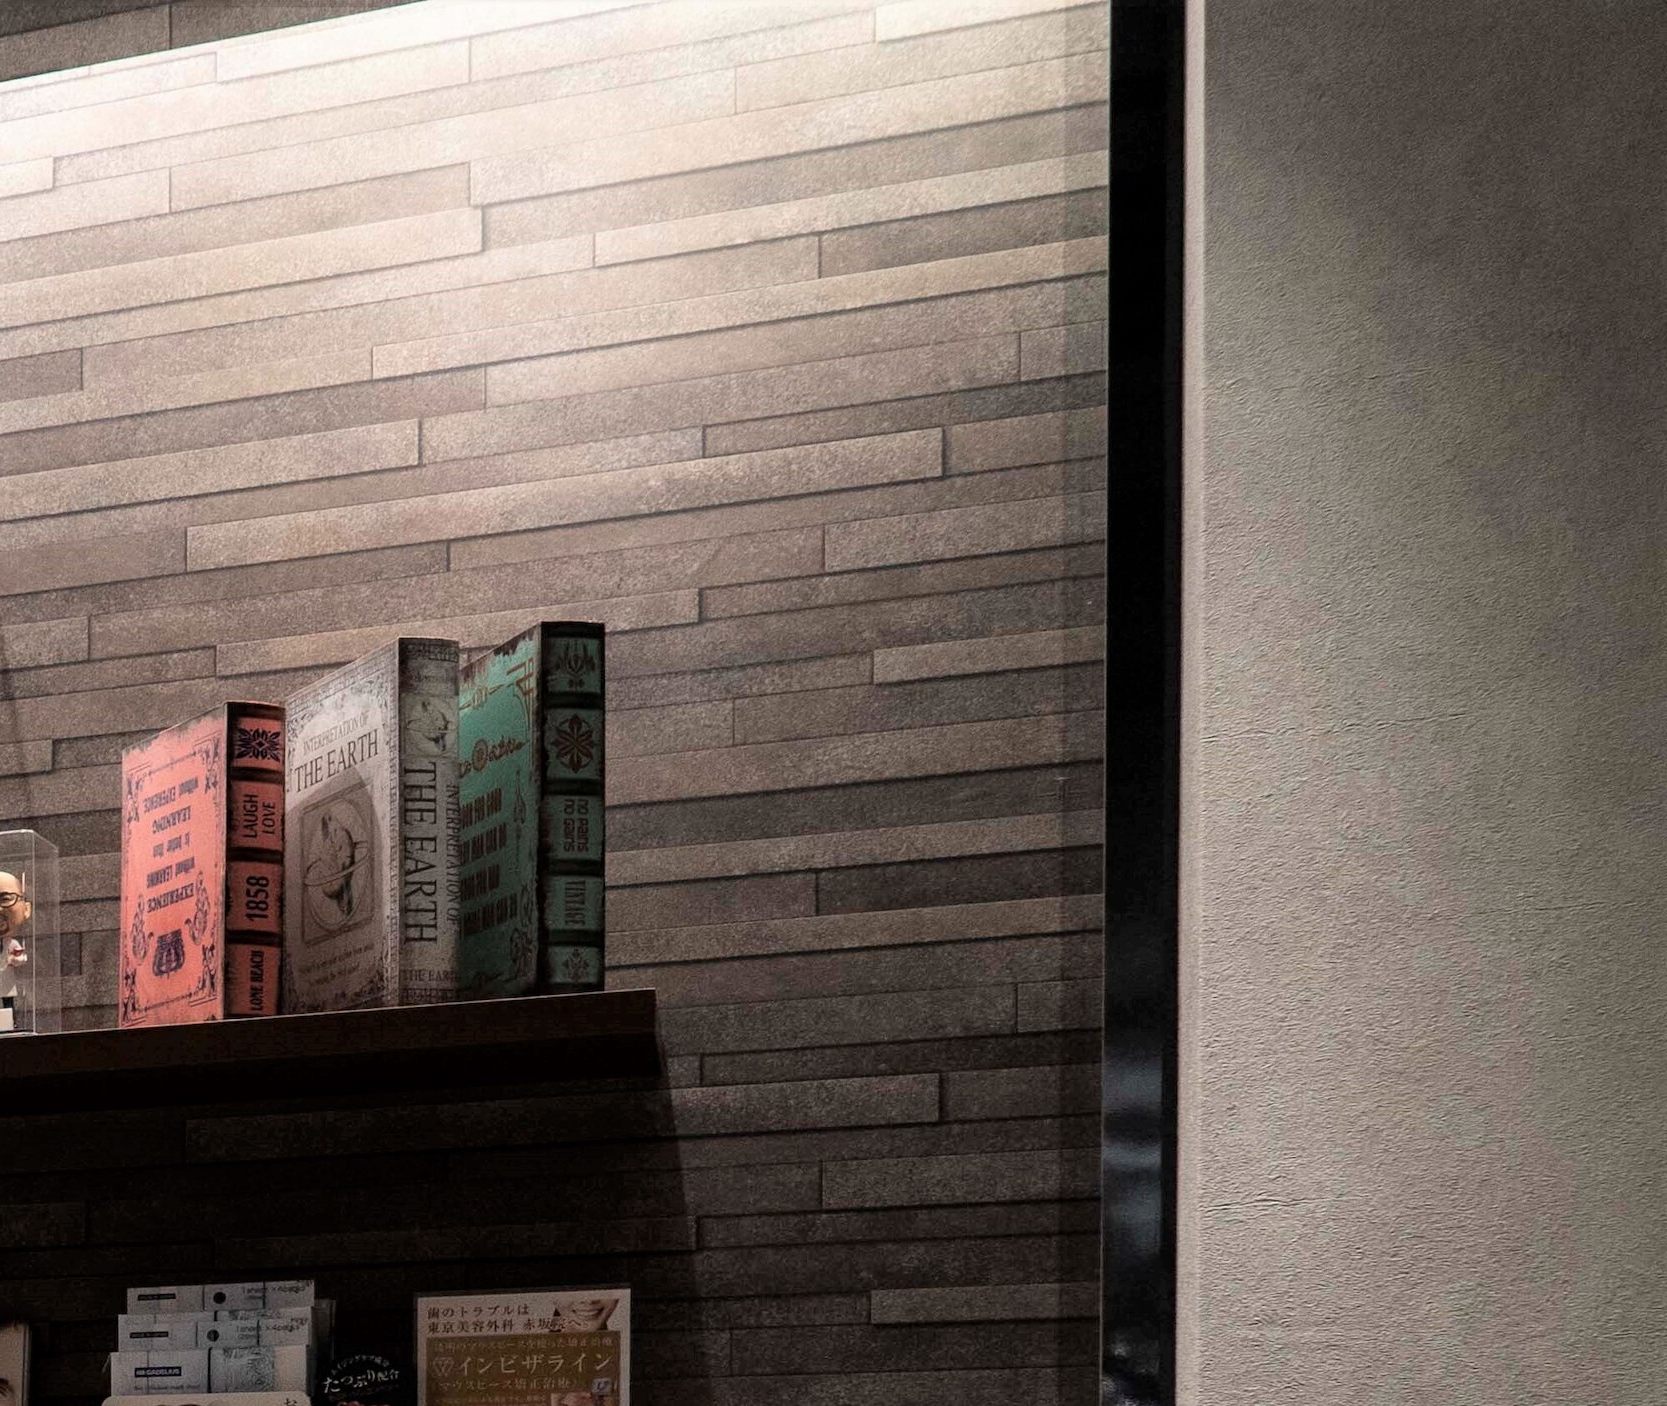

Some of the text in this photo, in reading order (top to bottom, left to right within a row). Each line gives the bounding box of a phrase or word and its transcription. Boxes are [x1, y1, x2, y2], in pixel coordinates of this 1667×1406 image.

[294, 729, 379, 796] THE EARTH
[152, 806, 192, 834] LEARNING
[242, 794, 259, 838] LAUGH
[262, 801, 276, 834] LOVE
[403, 762, 439, 945] THE EARTH
[445, 785, 461, 904] INTERPRETATION
[146, 882, 195, 914] EXPERIENCE
[245, 875, 269, 922] 1858
[427, 1304, 530, 1318] 歯のトラブルは
[427, 1320, 514, 1334] 東京美容外科
[460, 1352, 613, 1376] インビザライン
